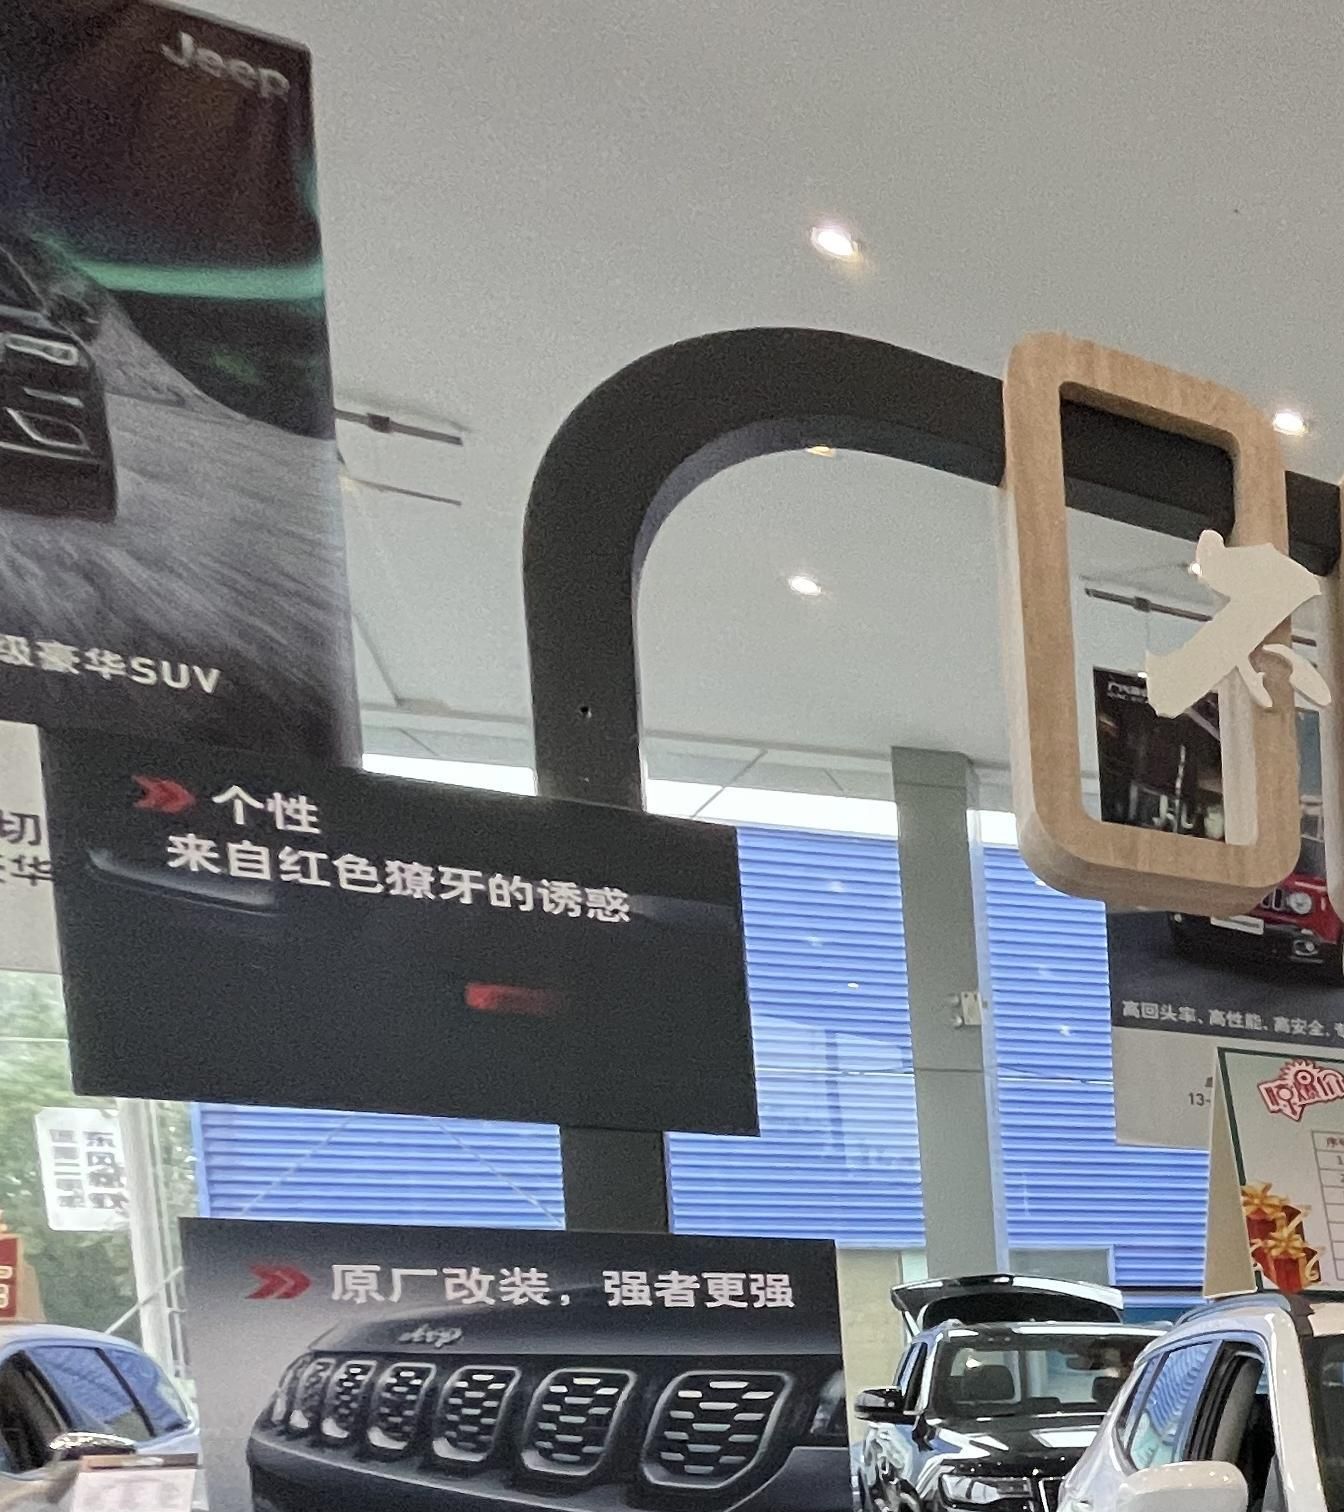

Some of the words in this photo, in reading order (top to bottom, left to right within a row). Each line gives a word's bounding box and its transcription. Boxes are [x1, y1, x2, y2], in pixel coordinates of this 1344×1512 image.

[162, 31, 290, 100] Jeep
[212, 784, 320, 835] 个性
[0, 853, 54, 887] 华
[167, 831, 632, 923] 来自红色獠牙的诱惑
